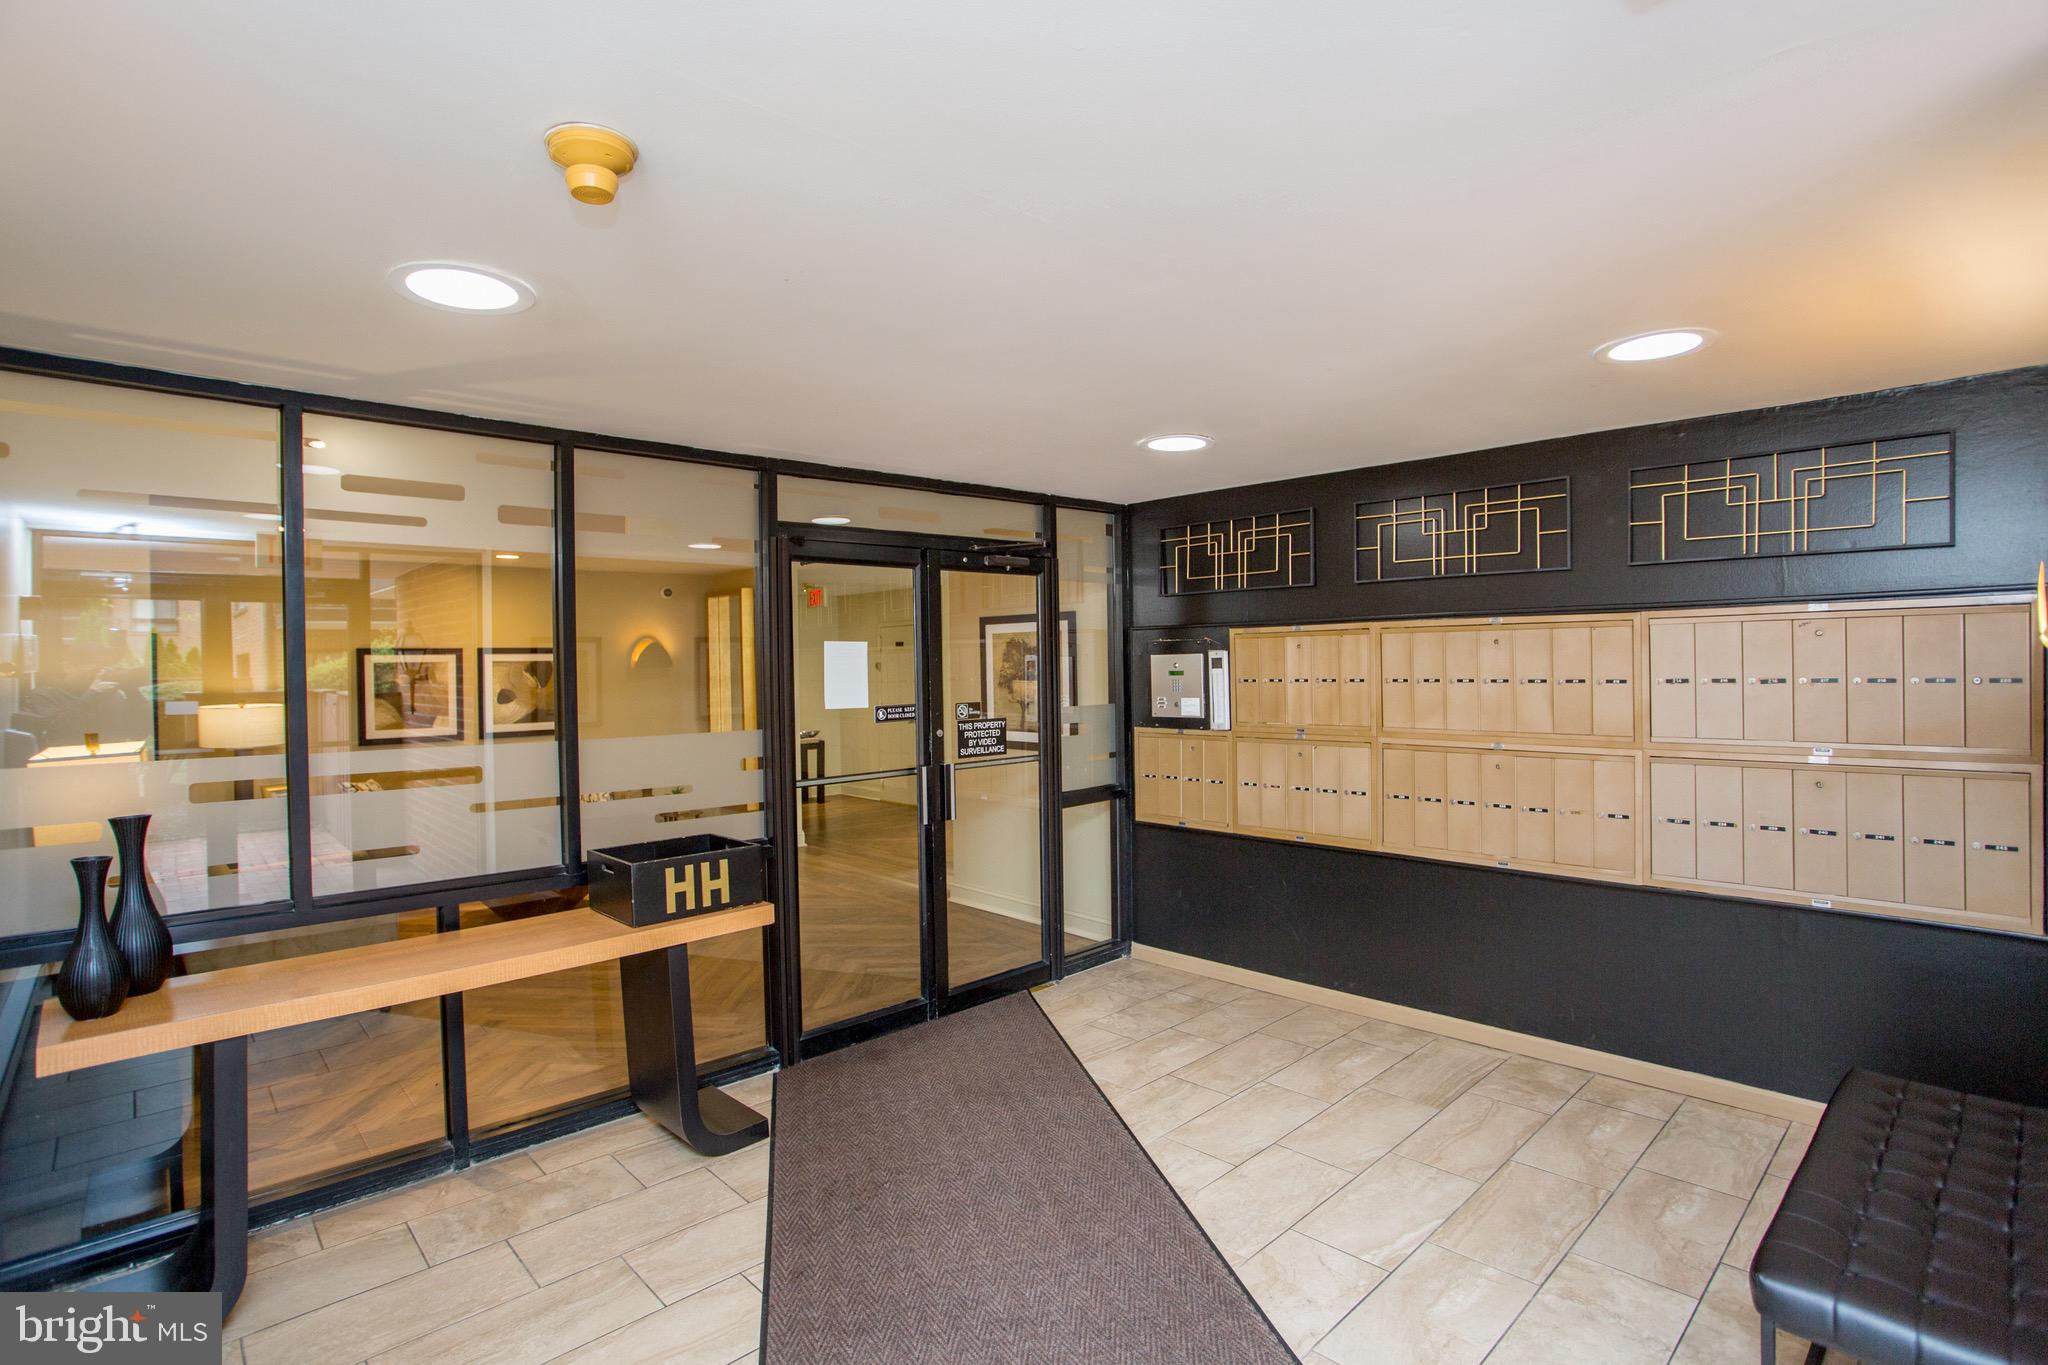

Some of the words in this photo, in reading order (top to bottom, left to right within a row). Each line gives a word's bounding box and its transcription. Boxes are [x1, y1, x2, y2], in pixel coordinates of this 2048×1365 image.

[809, 590, 822, 606] EXIT
[958, 722, 973, 730] THIS
[973, 720, 1006, 729] PROPERTY
[964, 729, 1001, 739] PROTECTED
[968, 738, 977, 747] BY
[978, 738, 997, 746] VIDEO
[960, 745, 1005, 756] SURVEILLANCE
[665, 858, 730, 915] HH
